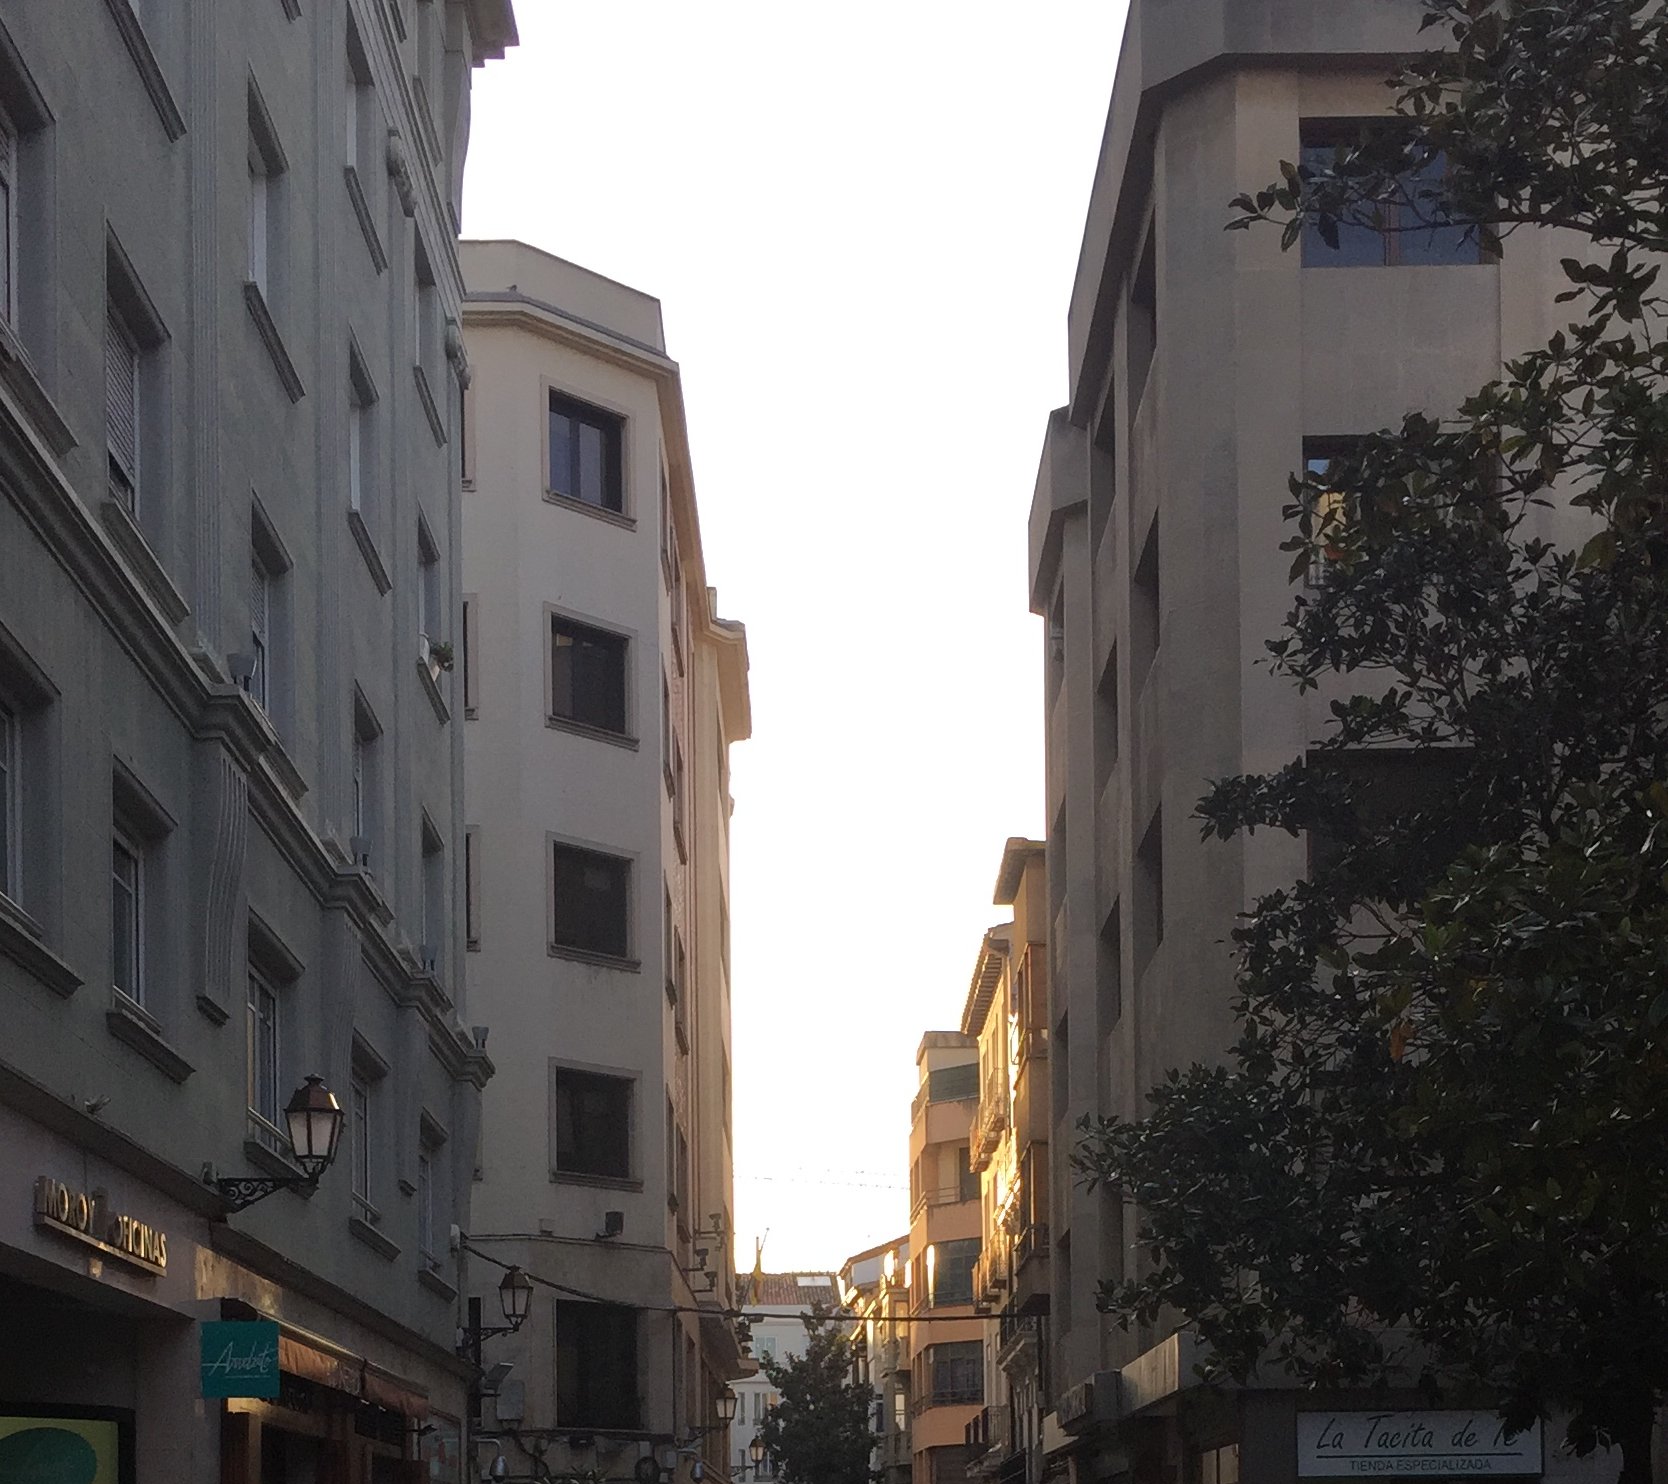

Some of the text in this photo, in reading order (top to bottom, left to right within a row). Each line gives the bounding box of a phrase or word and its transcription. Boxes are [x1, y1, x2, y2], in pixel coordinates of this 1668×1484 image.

[110, 1215, 168, 1269] OFICINAS
[1316, 1417, 1345, 1450] La
[1363, 1414, 1434, 1449] Tacita
[1451, 1418, 1479, 1449] de
[1350, 1458, 1492, 1472] TIENDA ESPECIALIZADA
